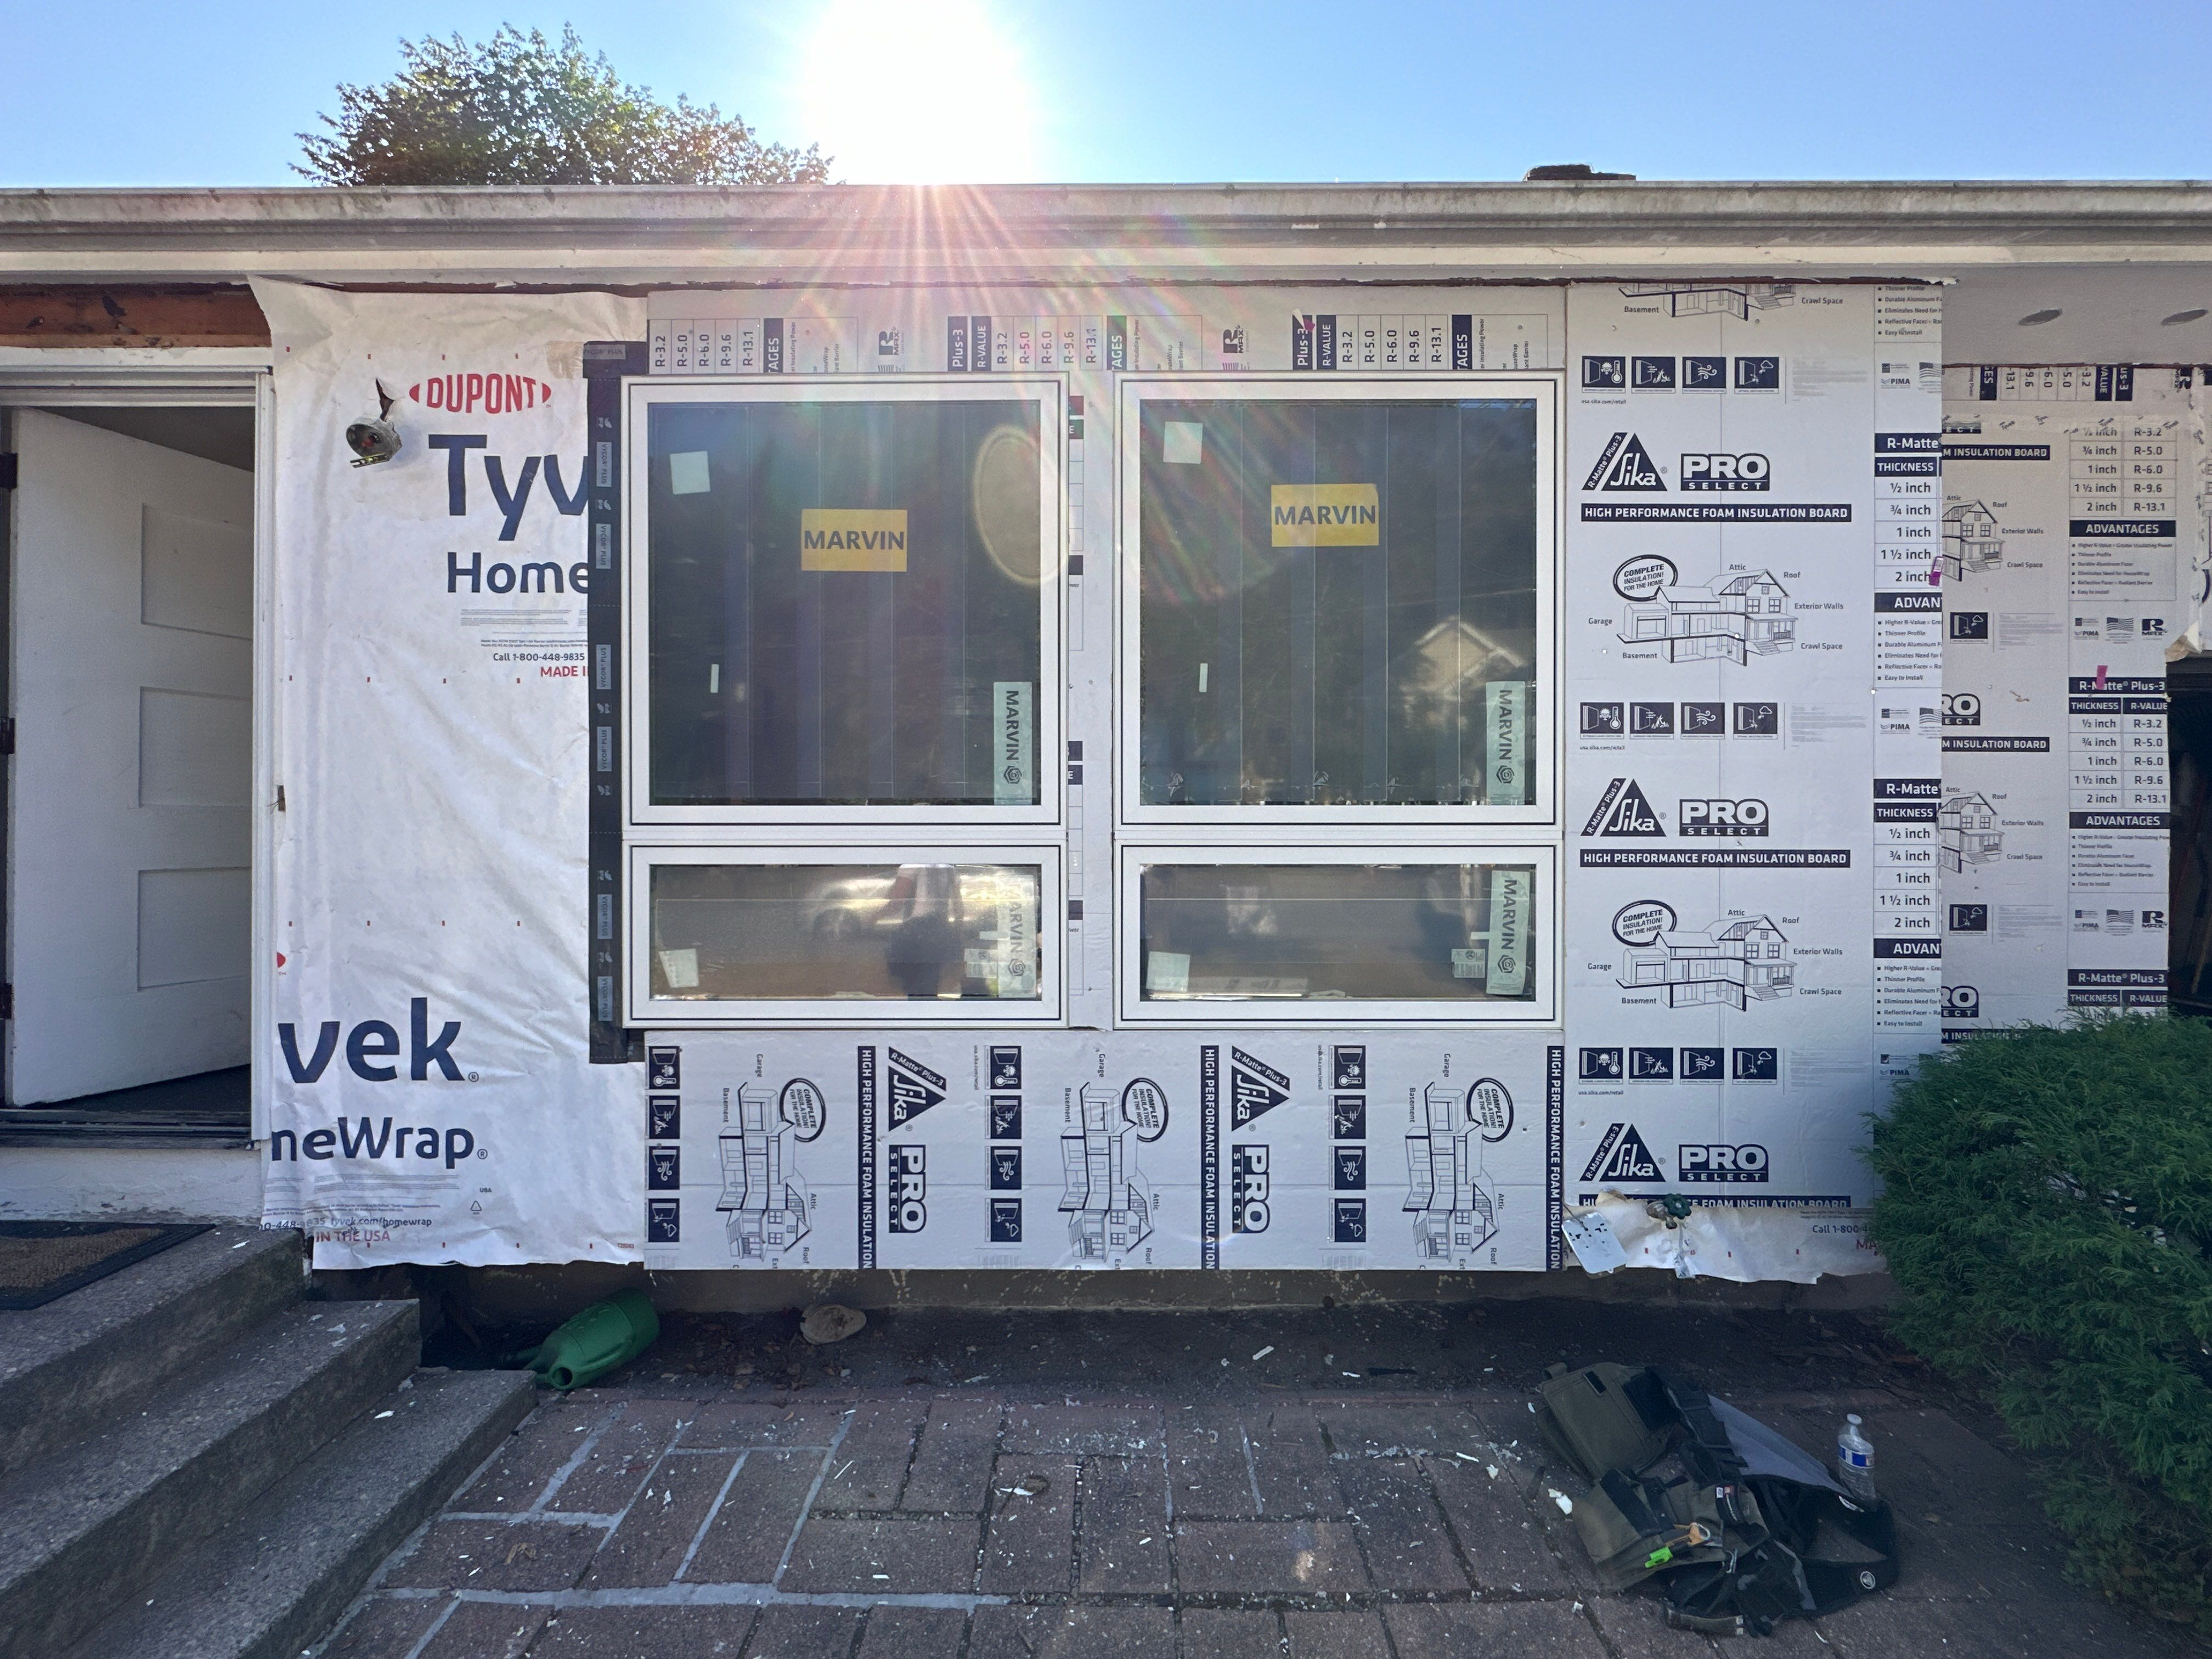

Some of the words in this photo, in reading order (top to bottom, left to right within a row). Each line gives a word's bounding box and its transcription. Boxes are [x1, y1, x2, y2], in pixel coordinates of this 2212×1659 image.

[655, 335, 665, 367] R-3.2
[677, 335, 687, 367] R-5.0
[699, 334, 709, 367] R-6.0
[721, 334, 731, 366] R-9.6
[743, 331, 753, 366] R-13.1
[952, 330, 963, 367] Plus-3
[978, 325, 986, 368] R-VALUE
[997, 332, 1007, 364] R-3.2
[1019, 332, 1029, 364] R-5.0
[1041, 331, 1052, 364] R-6.0
[1064, 331, 1074, 364] R-9.6
[1086, 328, 1096, 363] R-13.1
[1297, 328, 1308, 365] Plus-3
[1342, 331, 1352, 363] R-3.2
[1365, 331, 1375, 363] R-5.0
[1387, 330, 1397, 363] R-6.0
[1409, 330, 1419, 363] R-9.6
[1431, 327, 1441, 363] R-13.1
[427, 373, 536, 414] DUPONT
[1606, 435, 1621, 456] Plus-3
[1954, 448, 2012, 456] INSULATION
[2134, 447, 2162, 455] R-5.0
[1683, 456, 1767, 478] PRO
[1877, 463, 1933, 471] THICKNESS
[2134, 465, 2162, 474] R-6.0
[1906, 482, 1931, 493] inch
[2134, 484, 2162, 493] R-9.6
[1274, 506, 1375, 525] MARVIN
[1585, 507, 1611, 517] HIGH
[1616, 507, 1699, 517] PERFORMANCE
[1703, 507, 1734, 517] FOAM
[1737, 507, 1806, 517] INSULATION
[1809, 507, 1847, 517] BOARD
[1906, 505, 1931, 515] inch
[2134, 503, 2165, 511] R-13.1
[804, 531, 905, 549] MARVIN
[1897, 528, 1901, 537] 1
[1906, 527, 1931, 537] inch
[2086, 524, 2159, 534] ADVANTAGES
[1881, 550, 1886, 559] 1
[1906, 549, 1931, 559] inch
[447, 552, 588, 594] Home
[1624, 564, 1664, 577] COMPLETE
[1896, 572, 1901, 582] 2
[1906, 571, 1930, 582] inch
[1894, 597, 1942, 608] ADVAN
[1588, 618, 1612, 626] Garage
[493, 652, 510, 661] Call
[1822, 642, 1842, 651] Space
[541, 666, 578, 677] MADE
[1006, 691, 1020, 761] MARVIN
[1498, 690, 1512, 761] MARVIN
[1682, 802, 1766, 823] PRO
[2086, 816, 2160, 825] ADVANTAGES
[1584, 854, 1611, 864] HIGH
[1614, 854, 1698, 864] PERFORMANCE
[1702, 854, 1733, 864] FOAM
[1736, 854, 1805, 864] INSULATION
[1808, 854, 1846, 864] BOARD
[1503, 879, 1516, 950] MARVIN
[1588, 963, 1611, 971] Garage
[2130, 973, 2164, 983] Plus-3
[1820, 988, 1841, 996] Space
[862, 1050, 871, 1076] HIGH
[1551, 1050, 1560, 1076] HIGH
[862, 1080, 871, 1163] PERFORMANCE
[1491, 1088, 1505, 1129] COMPLETE
[1551, 1080, 1560, 1163] PERFORMANCE
[1681, 1147, 1765, 1170] PRO
[862, 1167, 871, 1198] FOAM
[902, 1149, 924, 1229] PRO
[1551, 1167, 1560, 1198] FOAM
[317, 1232, 330, 1242] IN
[364, 1231, 390, 1241] USA
[862, 1200, 871, 1269] INSULATION
[1550, 1200, 1560, 1269] INSULATION
[1813, 1224, 1830, 1233] Call
